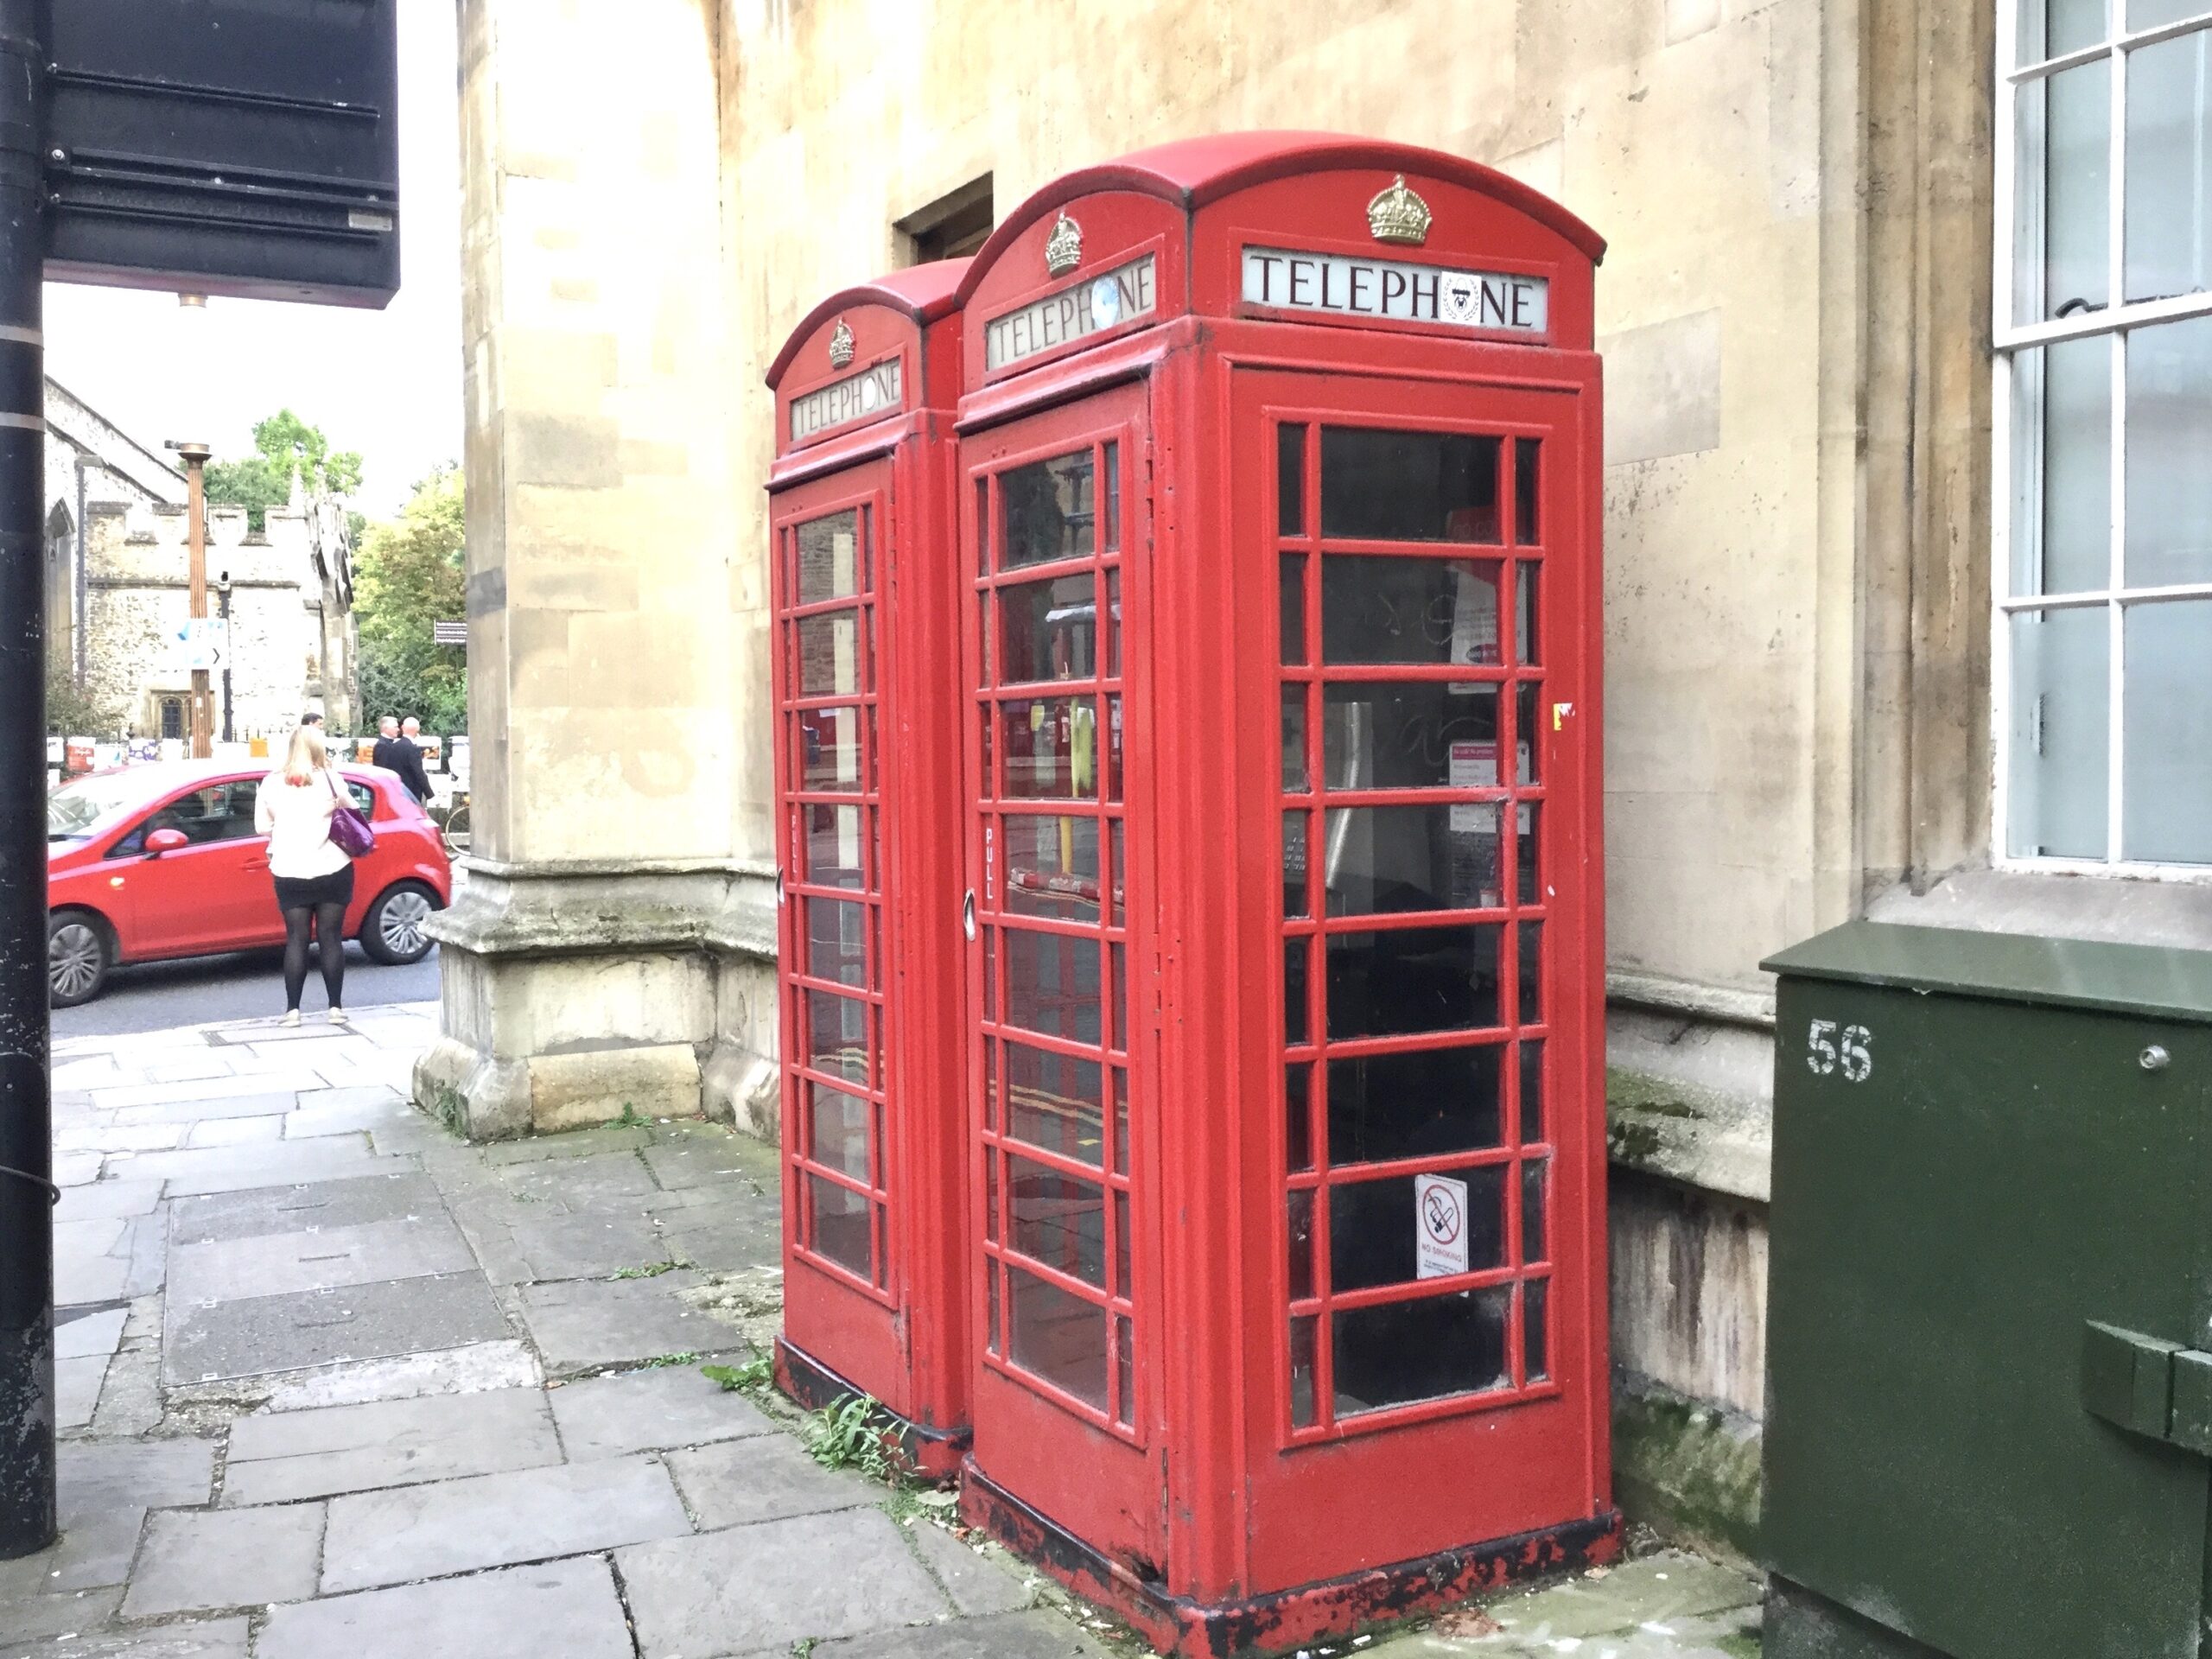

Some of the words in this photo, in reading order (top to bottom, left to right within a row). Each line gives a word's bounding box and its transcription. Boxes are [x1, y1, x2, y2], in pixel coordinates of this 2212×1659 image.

[995, 263, 1151, 362] TELEPHNE
[1249, 255, 1534, 327] TELEPHNE
[1807, 1018, 1872, 1083] 56
[1421, 1243, 1431, 1253] NO
